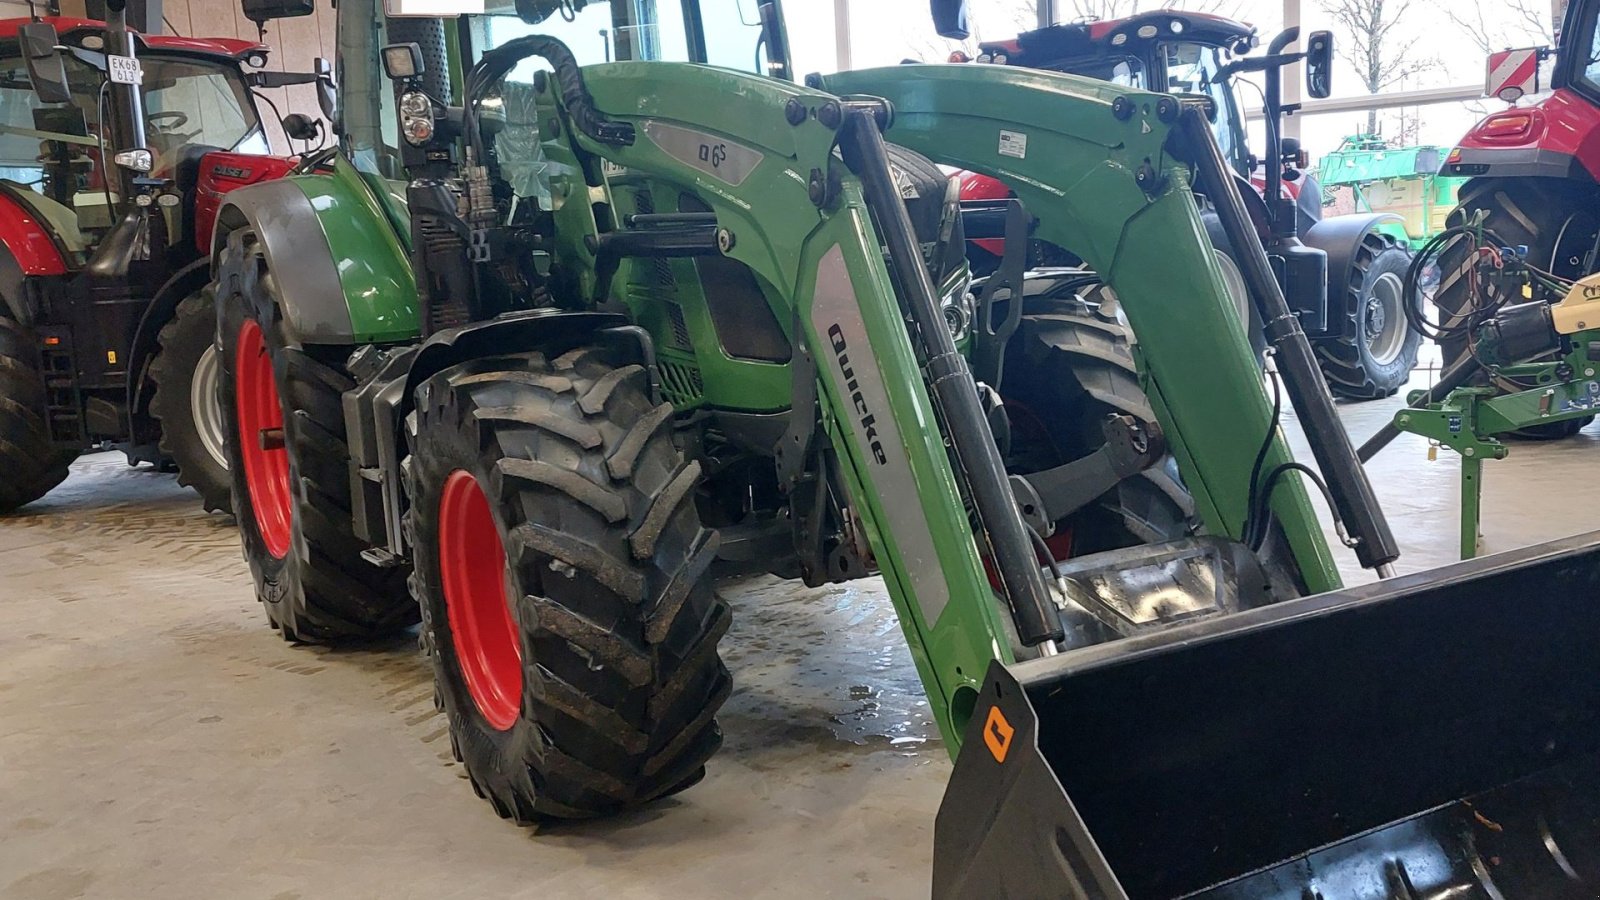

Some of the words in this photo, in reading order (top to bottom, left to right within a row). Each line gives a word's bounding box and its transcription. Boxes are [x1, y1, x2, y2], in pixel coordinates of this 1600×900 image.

[112, 58, 137, 71] EK68
[117, 70, 135, 82] 613
[828, 323, 887, 466] Quicke
